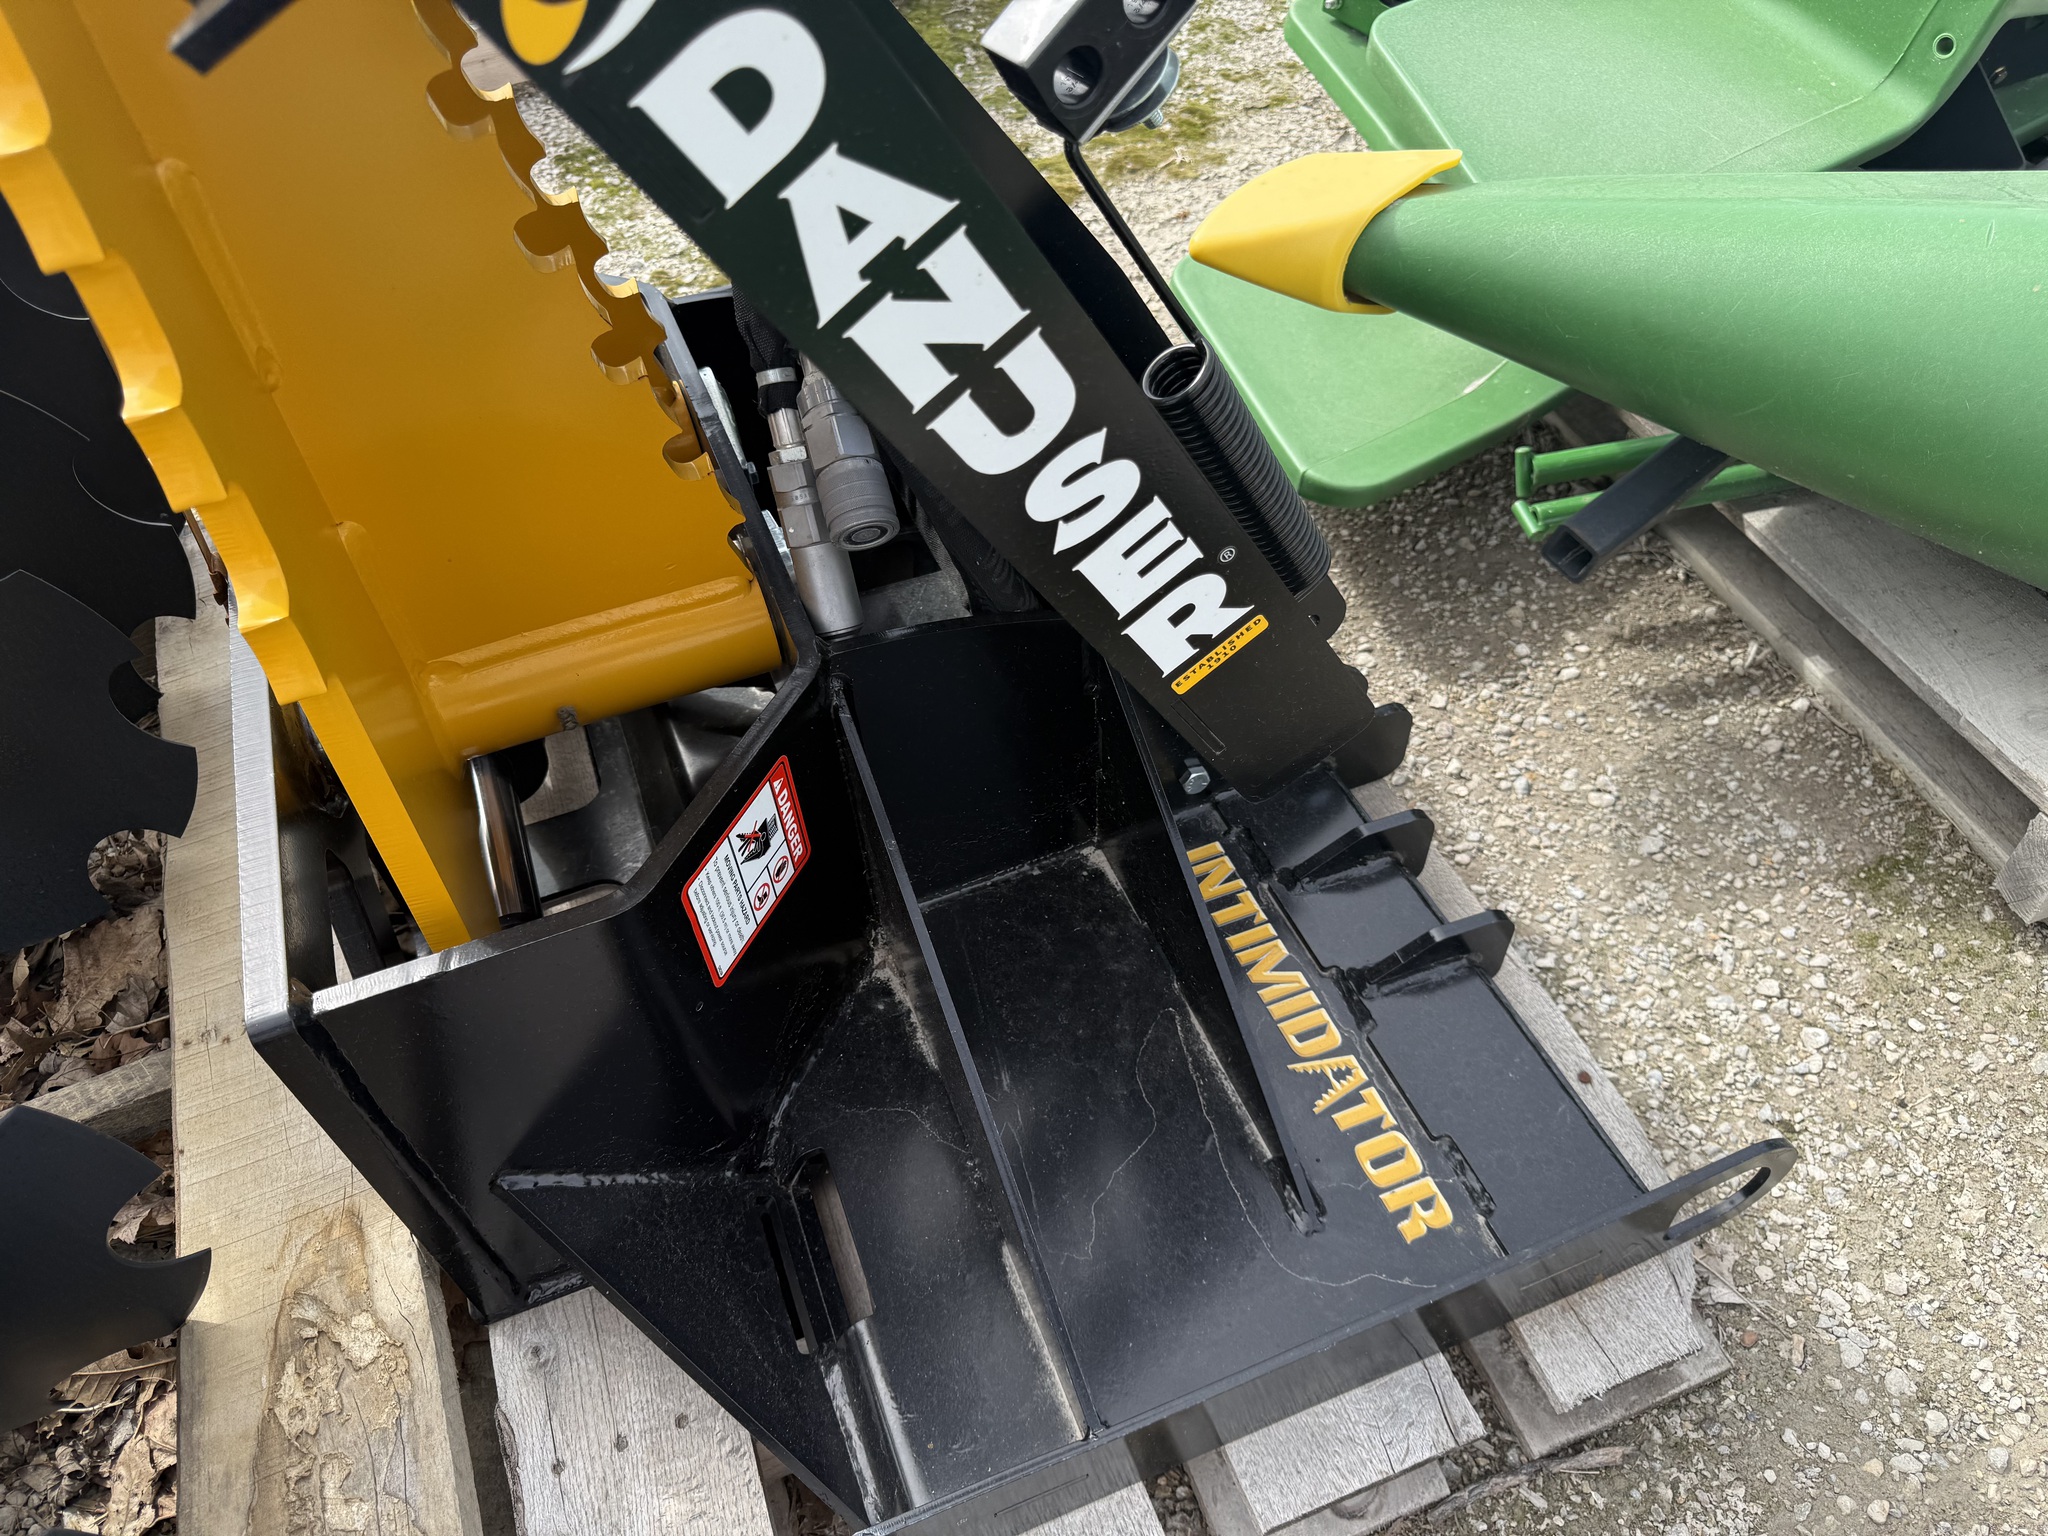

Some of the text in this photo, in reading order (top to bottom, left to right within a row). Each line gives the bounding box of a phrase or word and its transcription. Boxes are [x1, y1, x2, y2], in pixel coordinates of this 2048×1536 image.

[629, 8, 1253, 677] DANUSER
[1175, 617, 1262, 688] ESTABLISHED
[1206, 645, 1237, 671] 1910
[777, 792, 803, 863] DANGER
[715, 865, 726, 888] prevent
[722, 886, 733, 907] serious
[728, 905, 738, 923] injury
[723, 854, 751, 926] MOVING PARTS HAZARD
[1187, 841, 1453, 1244] INTIMIDATOR
